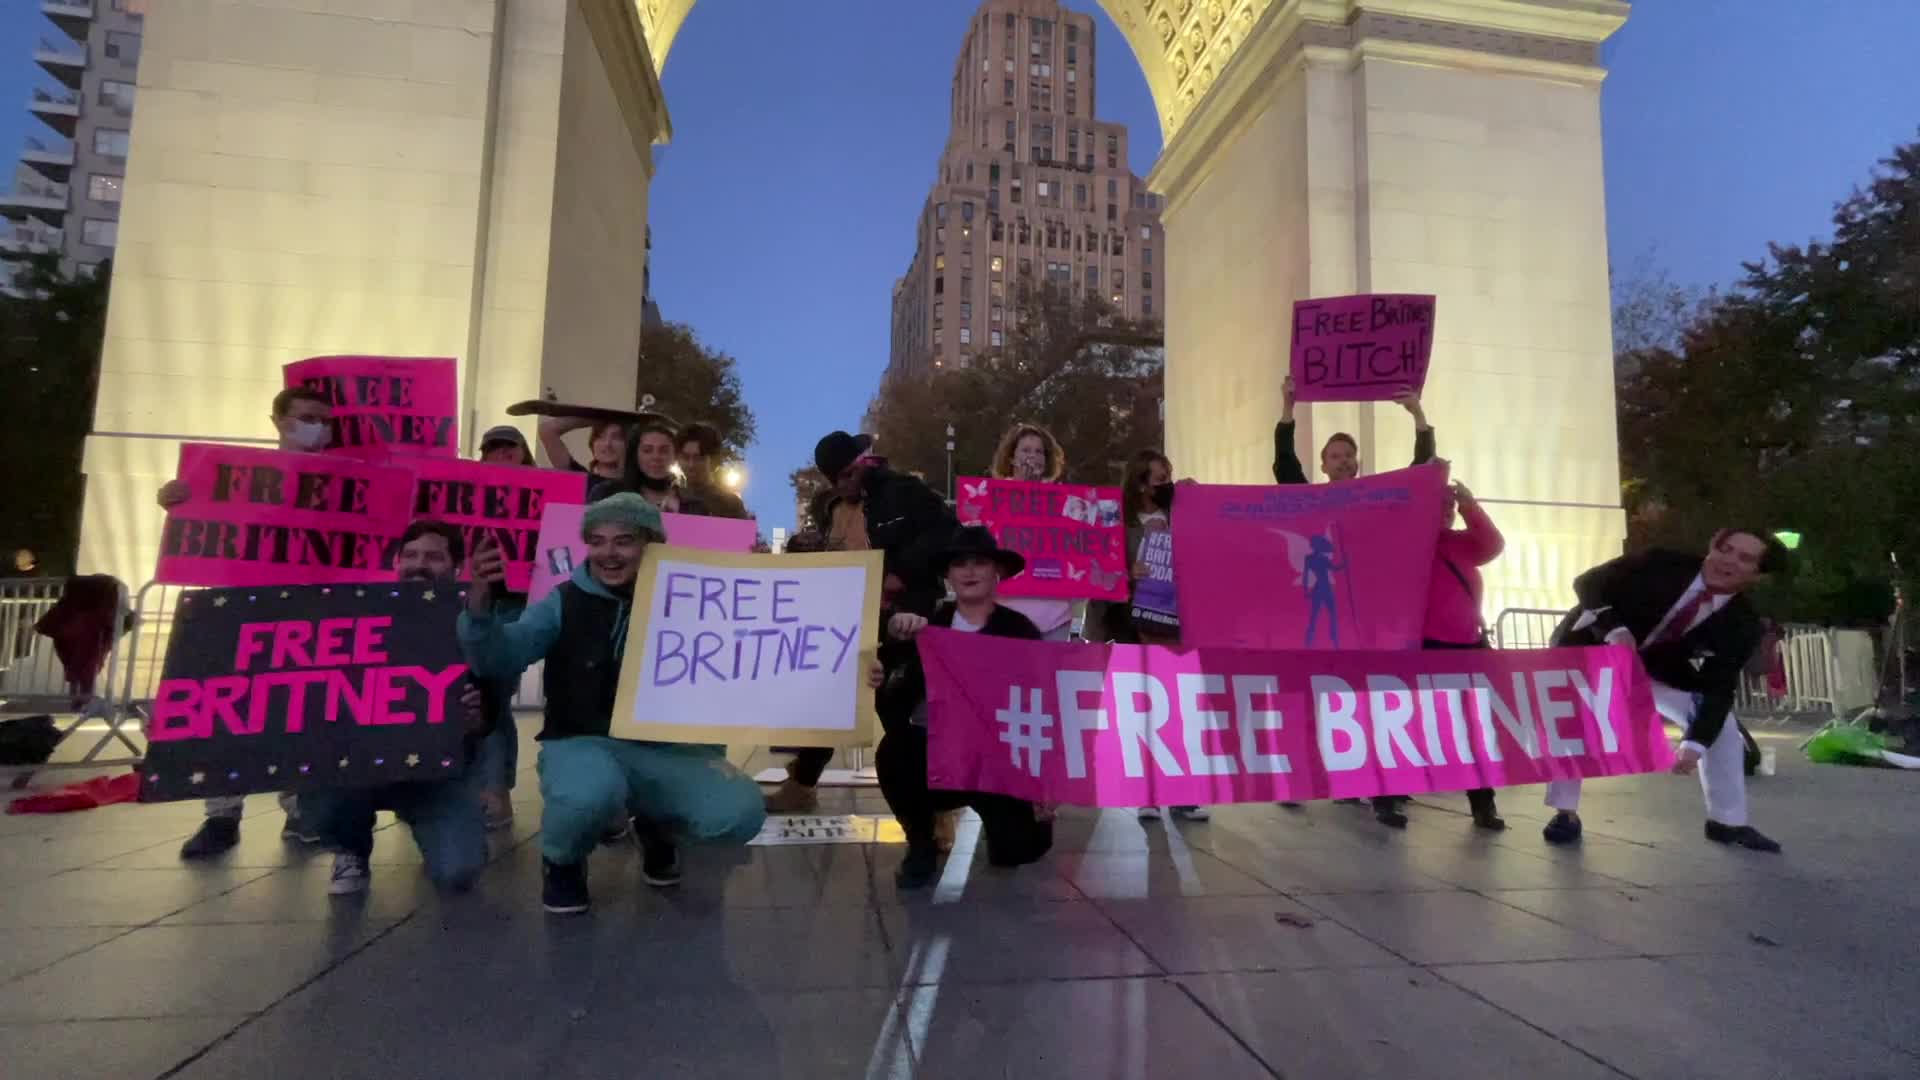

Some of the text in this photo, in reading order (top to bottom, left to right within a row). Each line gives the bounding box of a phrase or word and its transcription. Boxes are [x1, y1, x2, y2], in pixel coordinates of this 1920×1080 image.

[1294, 304, 1364, 344] FREE
[1302, 326, 1428, 385] BITCH!
[212, 463, 370, 515] FREE
[415, 479, 544, 521] FREE
[991, 487, 1061, 517] FREE
[165, 517, 400, 572] BRITNEY
[1003, 526, 1113, 556] BRITNEY
[663, 572, 801, 624] FREE
[235, 615, 393, 672] FREE
[149, 664, 471, 742] BRITNEY
[995, 667, 1619, 779] #FREE BRITNEY
